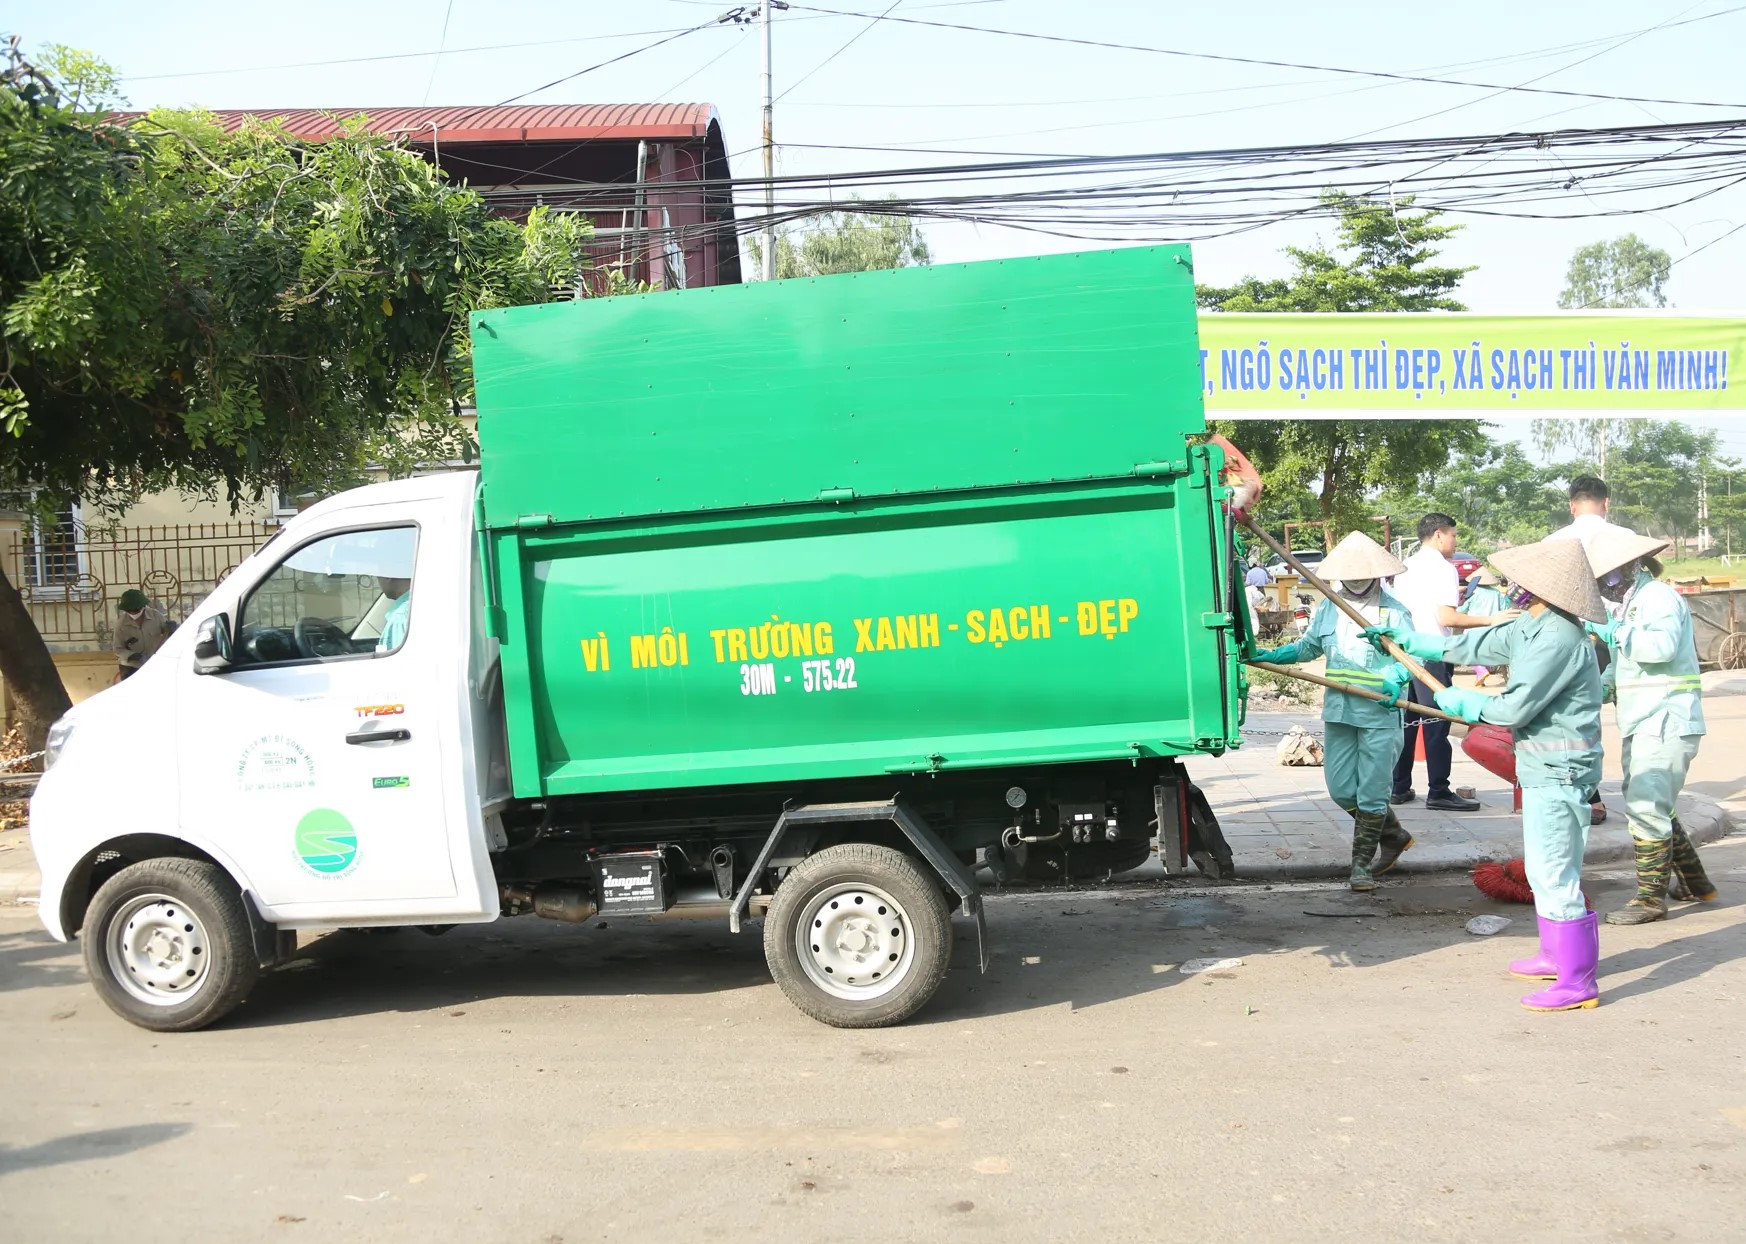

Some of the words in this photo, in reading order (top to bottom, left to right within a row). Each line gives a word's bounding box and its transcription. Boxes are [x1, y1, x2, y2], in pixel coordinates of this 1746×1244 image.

[1221, 341, 1271, 390] NGÕ
[1279, 349, 1343, 399] SẠCH
[1350, 340, 1388, 390] THÌ
[1395, 349, 1445, 399] ĐẸP,
[1452, 341, 1484, 390] XÃ
[1491, 349, 1553, 399] SẠCH
[1560, 341, 1596, 390] THÌ
[1603, 341, 1649, 390] VĂN
[1656, 350, 1727, 390] MINH!
[580, 631, 610, 672] VÌ
[630, 626, 689, 669] MÔI
[709, 614, 835, 663] TRƯỜNG
[853, 612, 940, 653] XANH
[966, 604, 1051, 648] SẠCH
[1076, 598, 1139, 640] ĐẸP
[740, 662, 777, 696] 30M
[801, 656, 858, 692] 575.22
[354, 704, 405, 717] TF220
